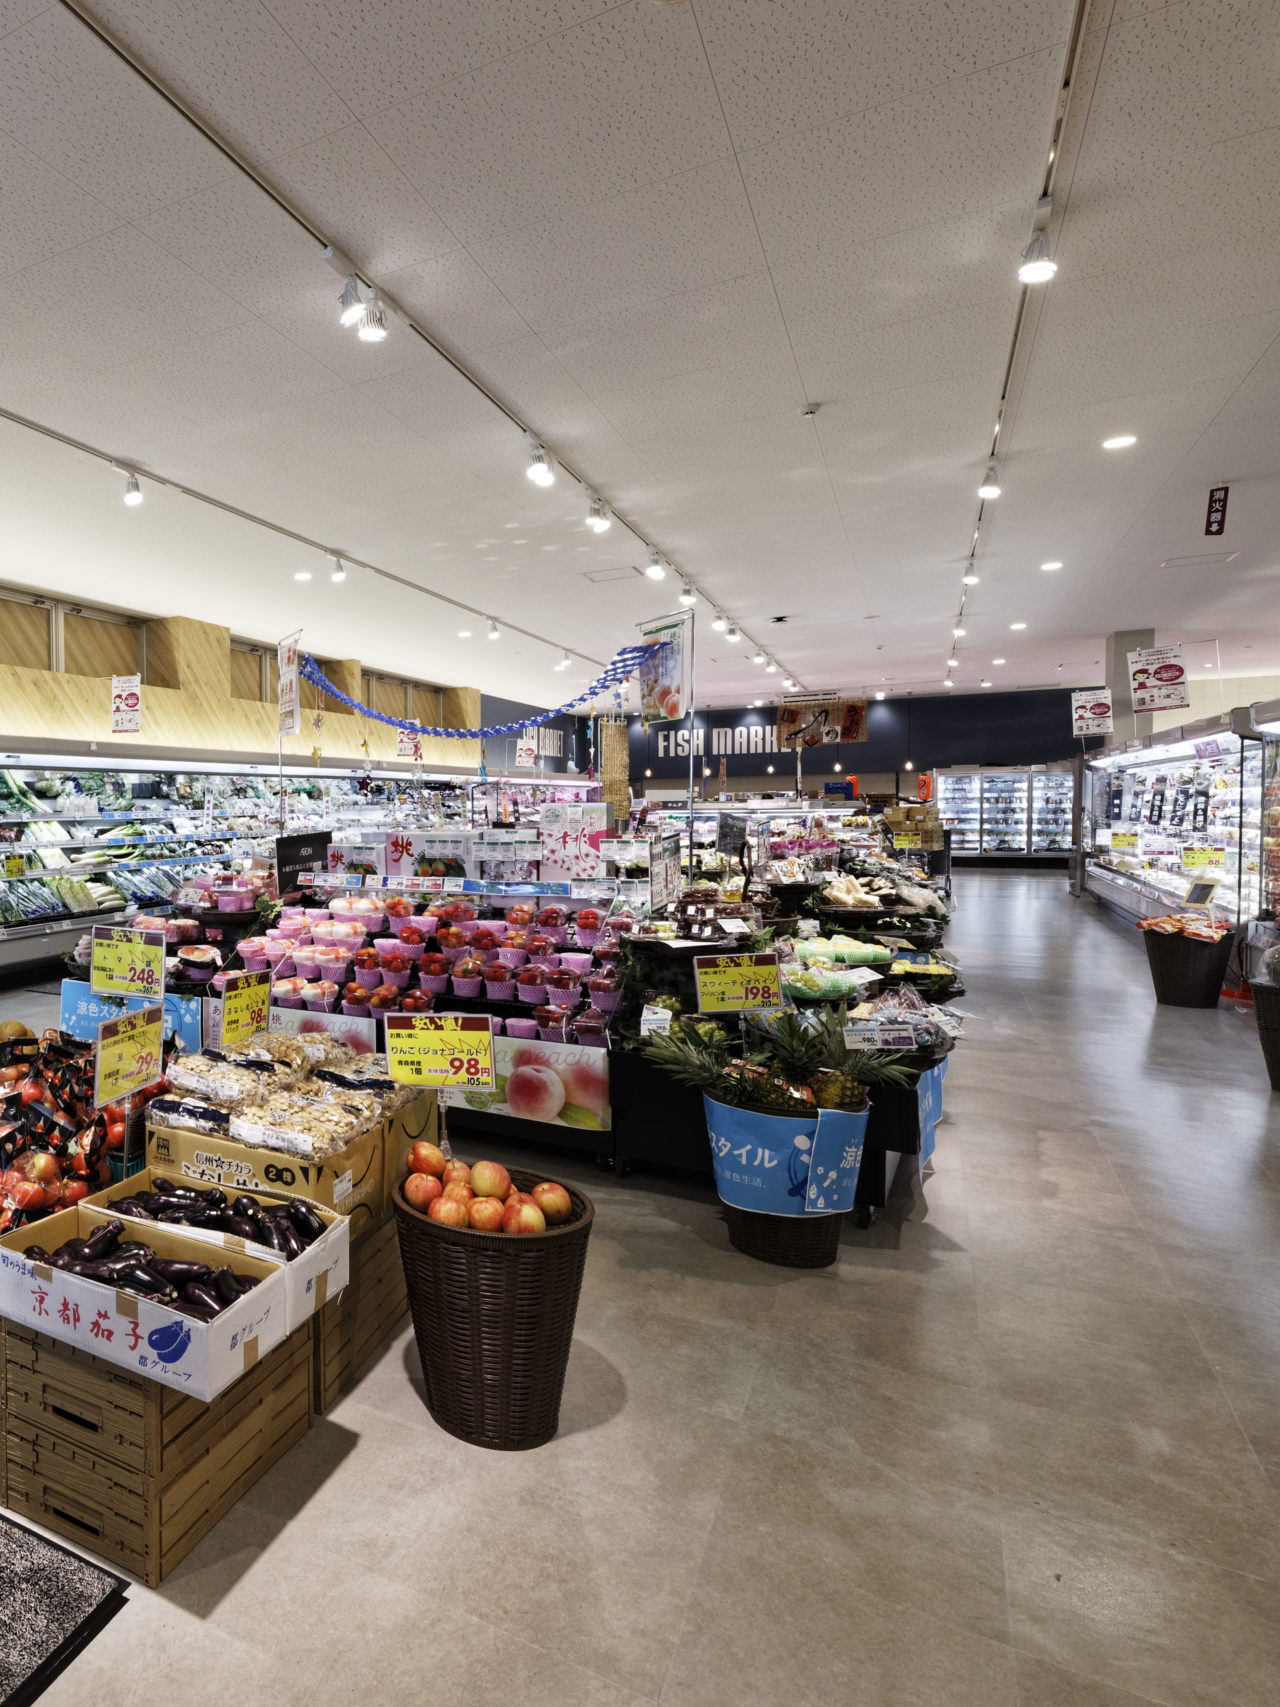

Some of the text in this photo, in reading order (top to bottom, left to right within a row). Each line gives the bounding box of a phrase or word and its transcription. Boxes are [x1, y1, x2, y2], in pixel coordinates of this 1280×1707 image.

[658, 725, 803, 757] FISH MARK
[330, 851, 345, 868] 桃
[391, 835, 414, 863] 桃
[128, 966, 160, 987] 248円
[744, 985, 779, 1000] 198円
[271, 1012, 282, 1025] 桃
[412, 1015, 463, 1031] 安い値!
[391, 1046, 488, 1057] りんご(ジョナゴールド)
[449, 1056, 490, 1077] 98円
[1, 1254, 37, 1281] 旬のうま味
[30, 1285, 145, 1351] 京都茄子
[230, 1305, 272, 1351] 都グループ
[138, 1354, 193, 1382] 都グループ
